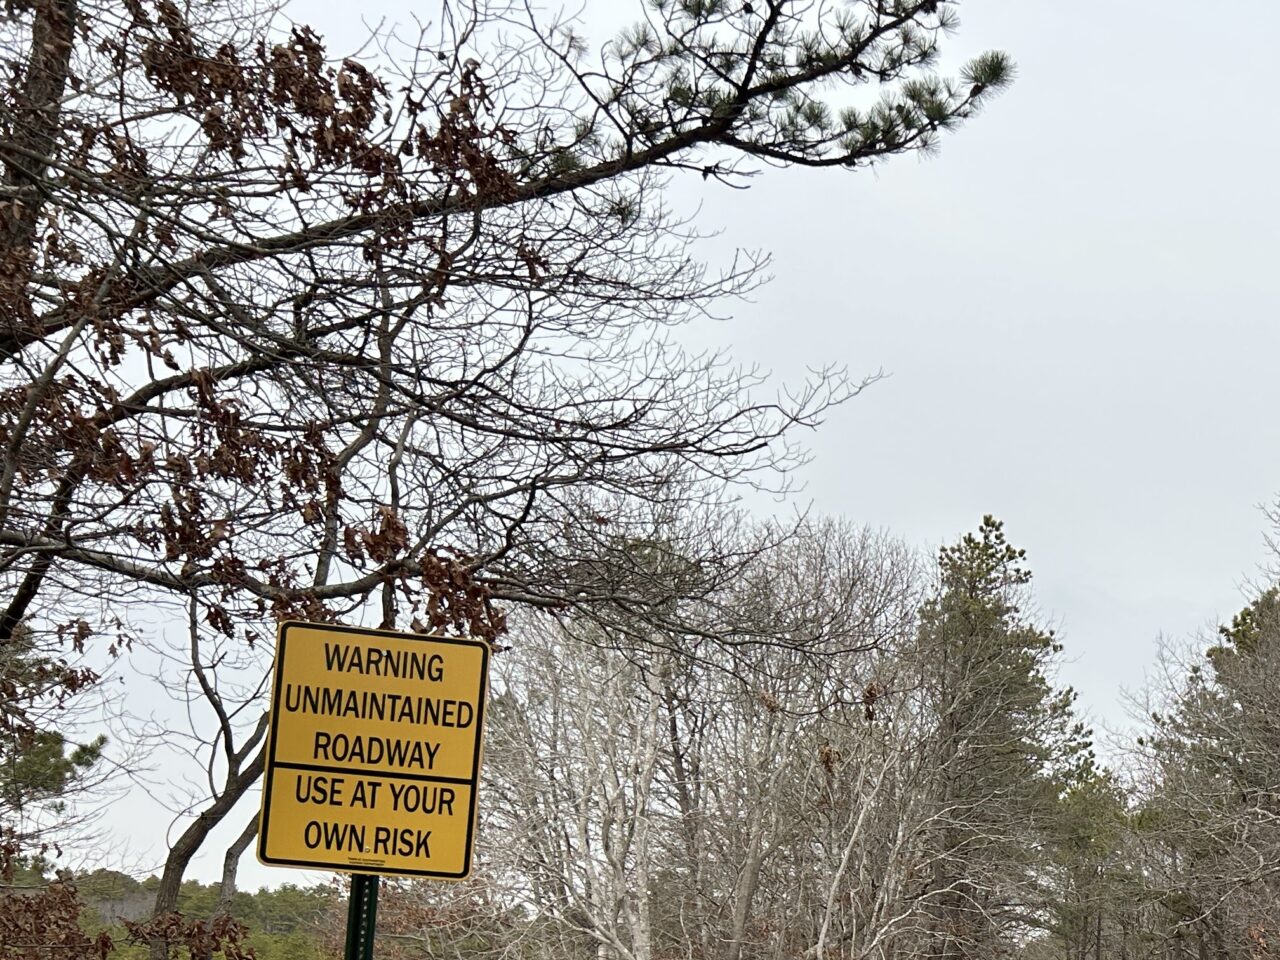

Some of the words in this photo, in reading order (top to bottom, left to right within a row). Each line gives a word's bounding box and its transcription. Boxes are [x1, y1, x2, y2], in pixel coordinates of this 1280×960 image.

[323, 642, 444, 683] WARNING
[285, 683, 474, 729] UNMAINTAINED
[313, 731, 441, 770] ROADWAY
[295, 774, 345, 807] USE
[350, 780, 383, 809] AT
[389, 783, 455, 816] YOUR
[303, 820, 365, 853] OWN
[373, 826, 433, 859] RISK
